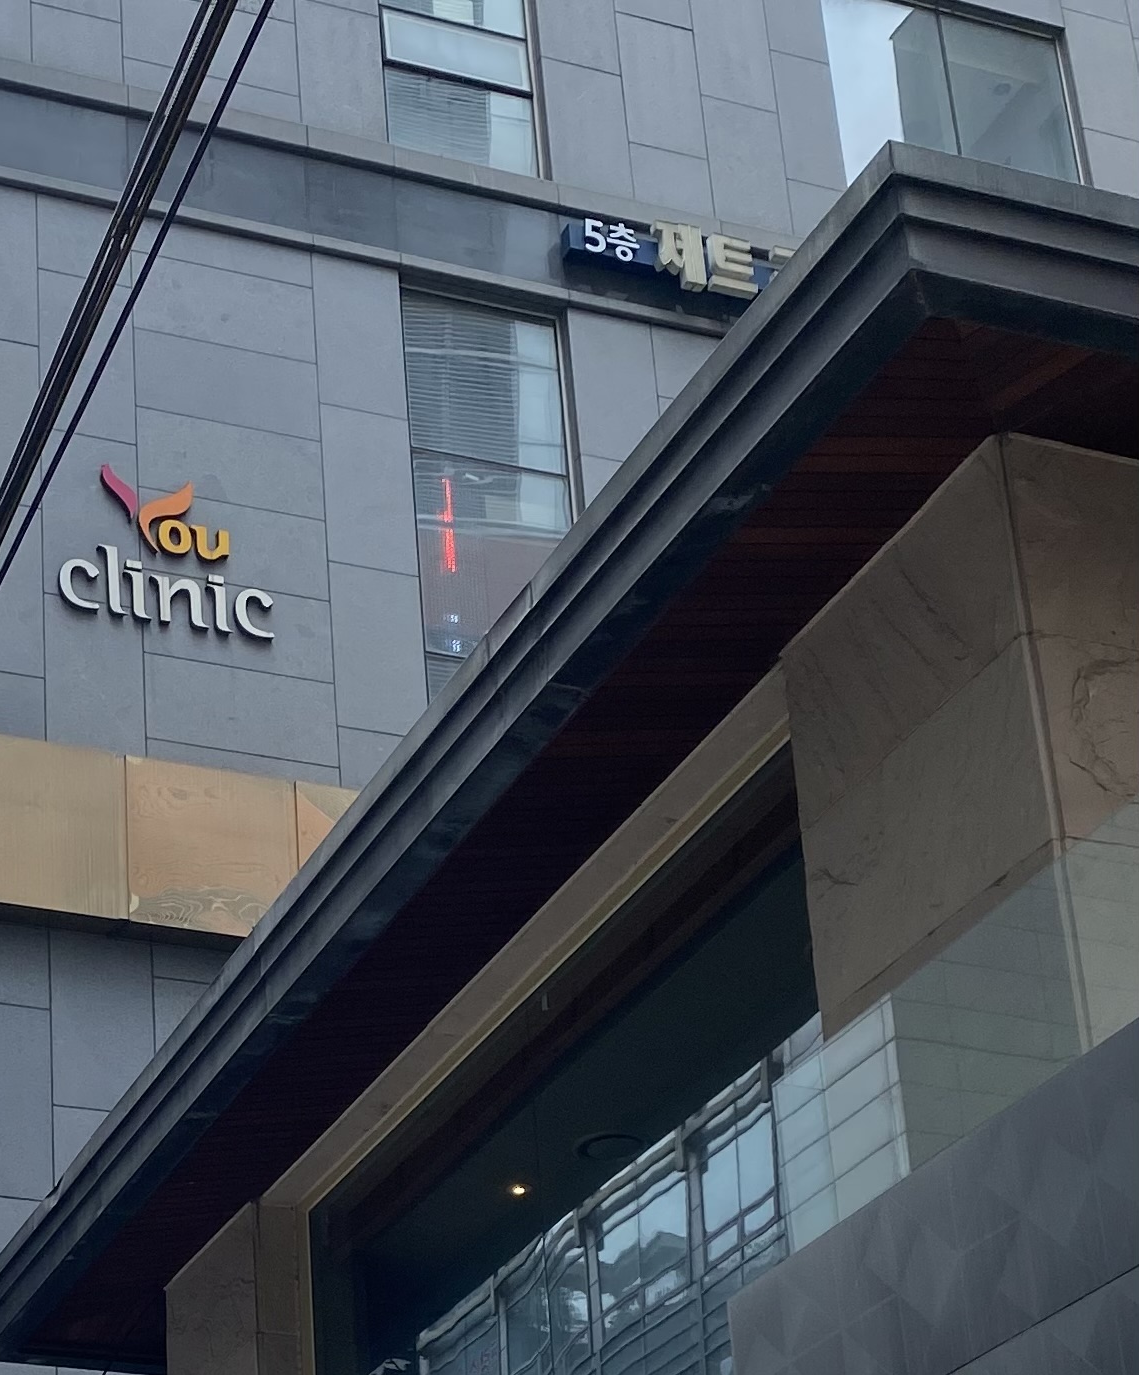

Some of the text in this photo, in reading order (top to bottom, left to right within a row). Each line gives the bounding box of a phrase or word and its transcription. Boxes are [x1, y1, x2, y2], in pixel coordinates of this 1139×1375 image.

[584, 218, 640, 262] 5층
[100, 463, 230, 560] You
[59, 543, 275, 643] clinic
